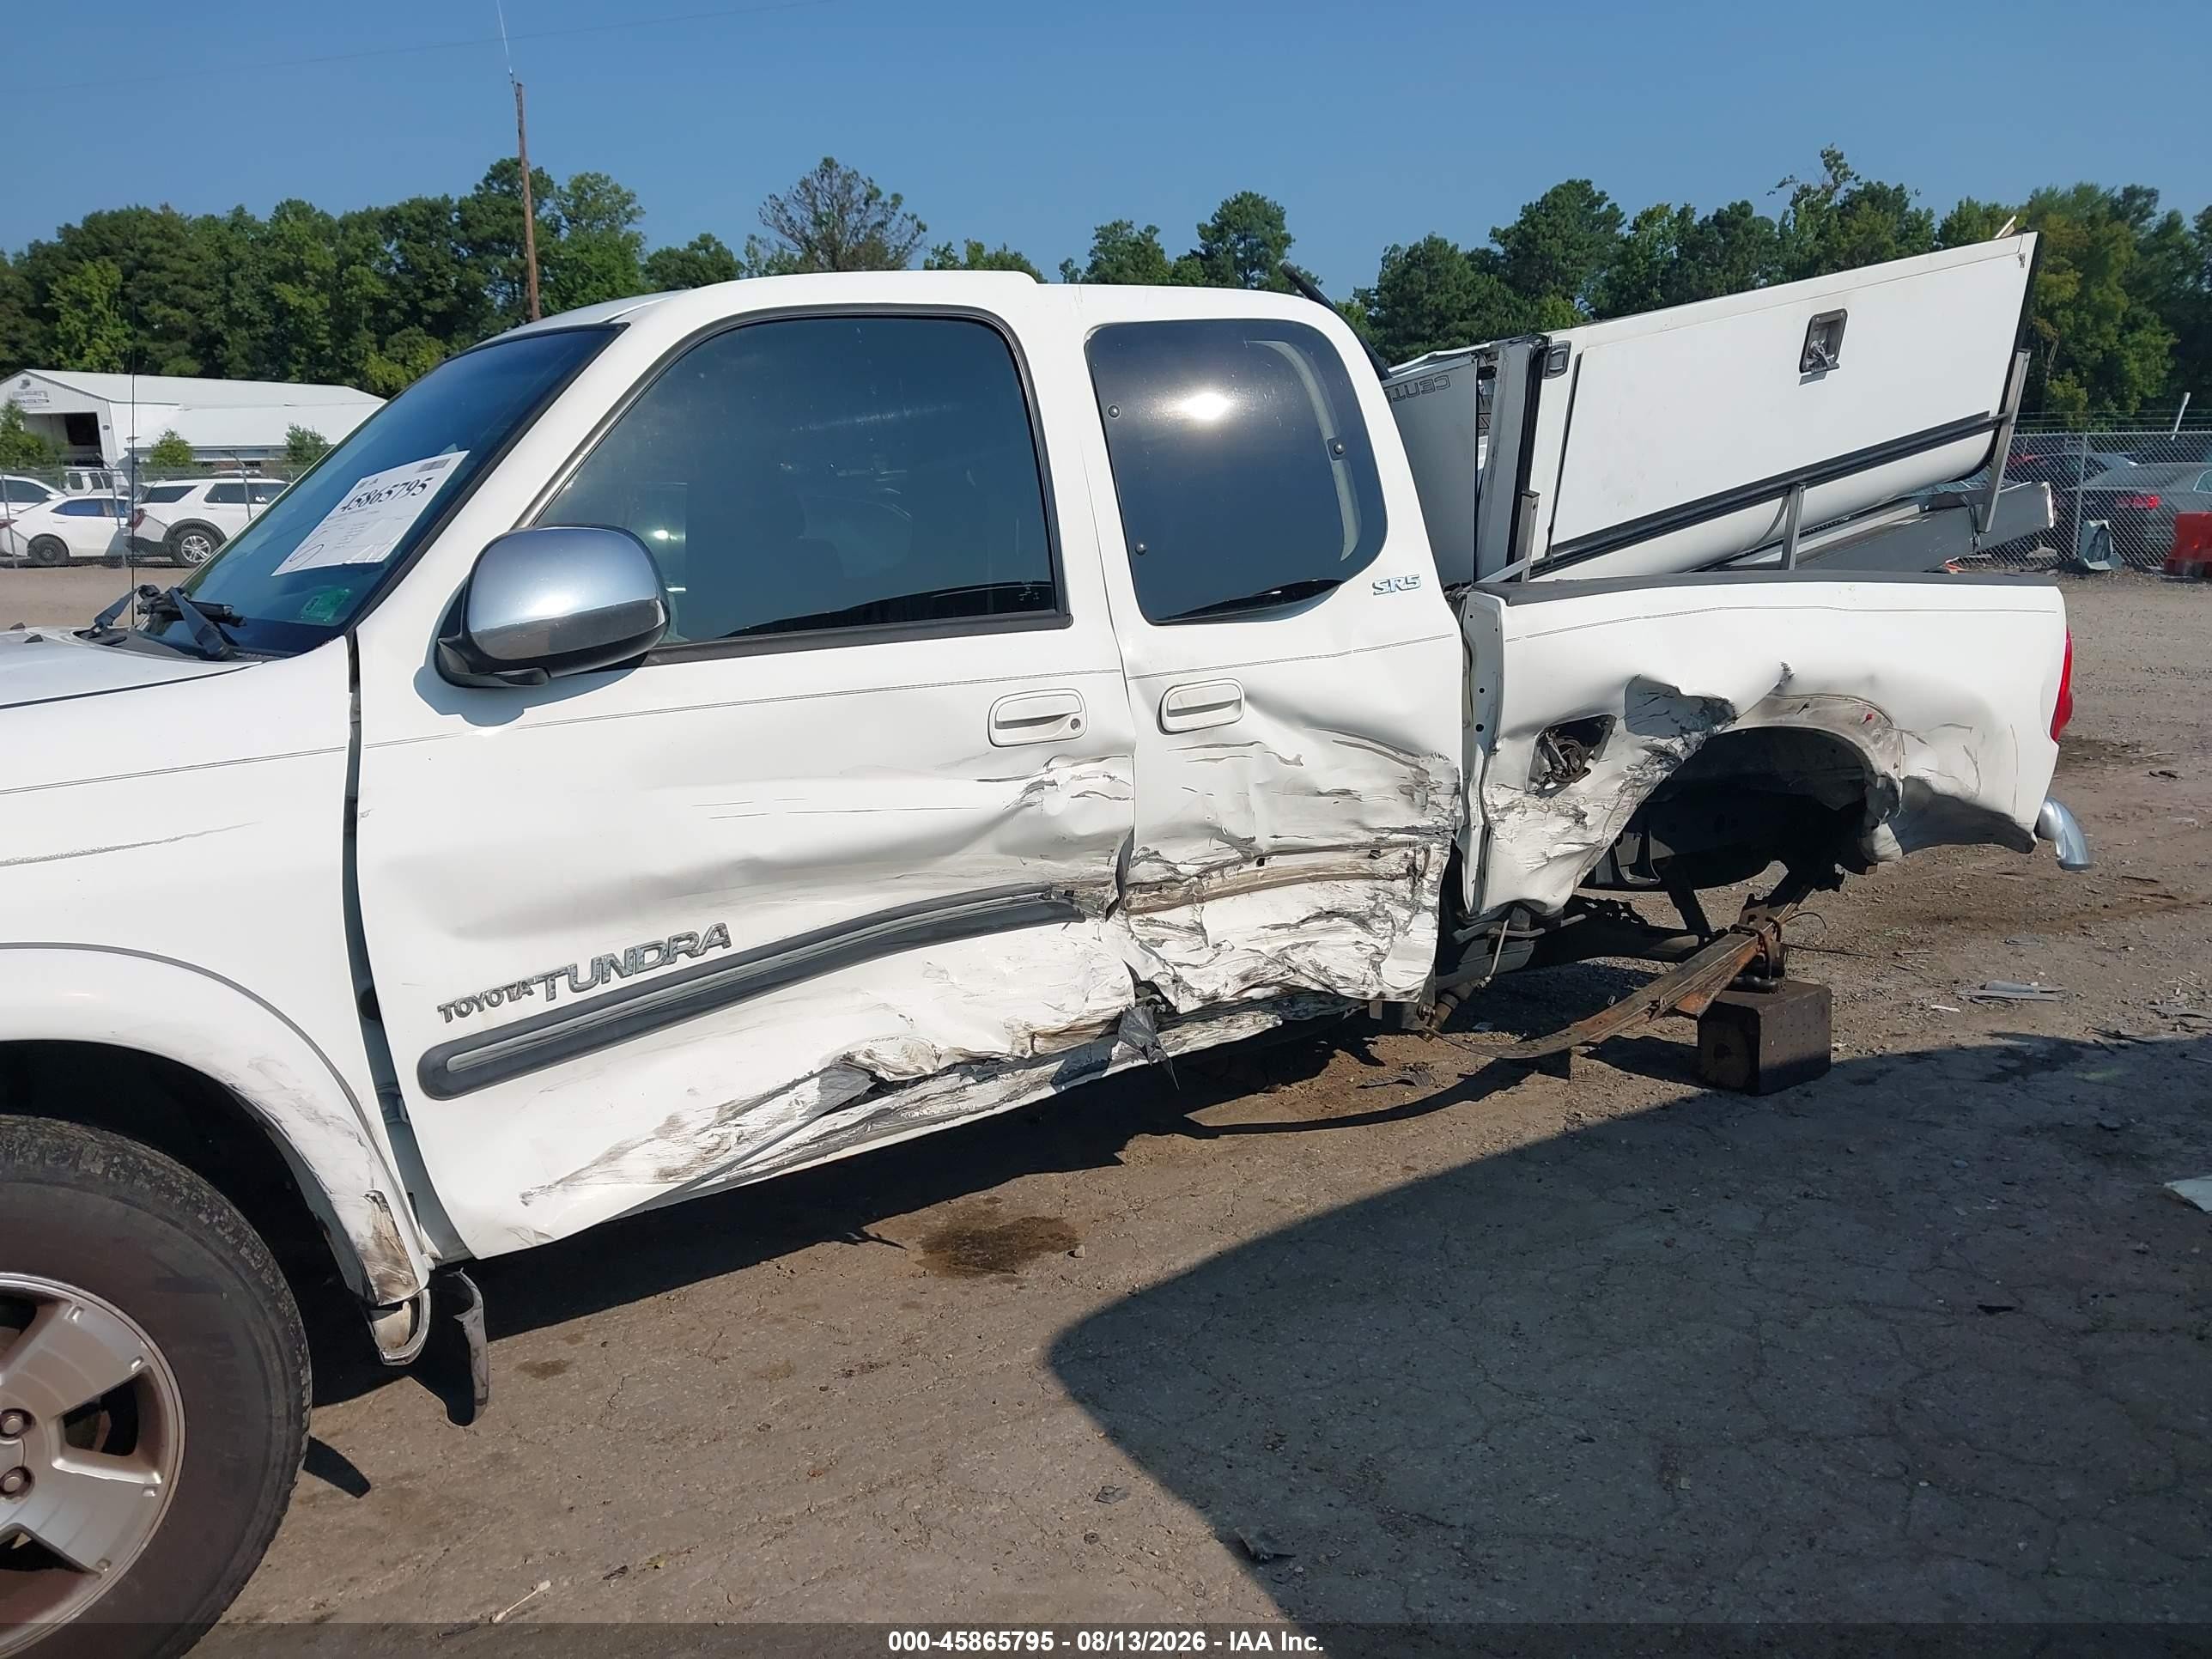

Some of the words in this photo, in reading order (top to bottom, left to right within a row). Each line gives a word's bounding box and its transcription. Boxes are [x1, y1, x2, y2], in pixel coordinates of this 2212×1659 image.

[340, 477, 434, 512] 45865795
[1372, 574, 1422, 596] SR5
[437, 978, 534, 1024] TOYOTA
[534, 921, 732, 1002] TUNDRA
